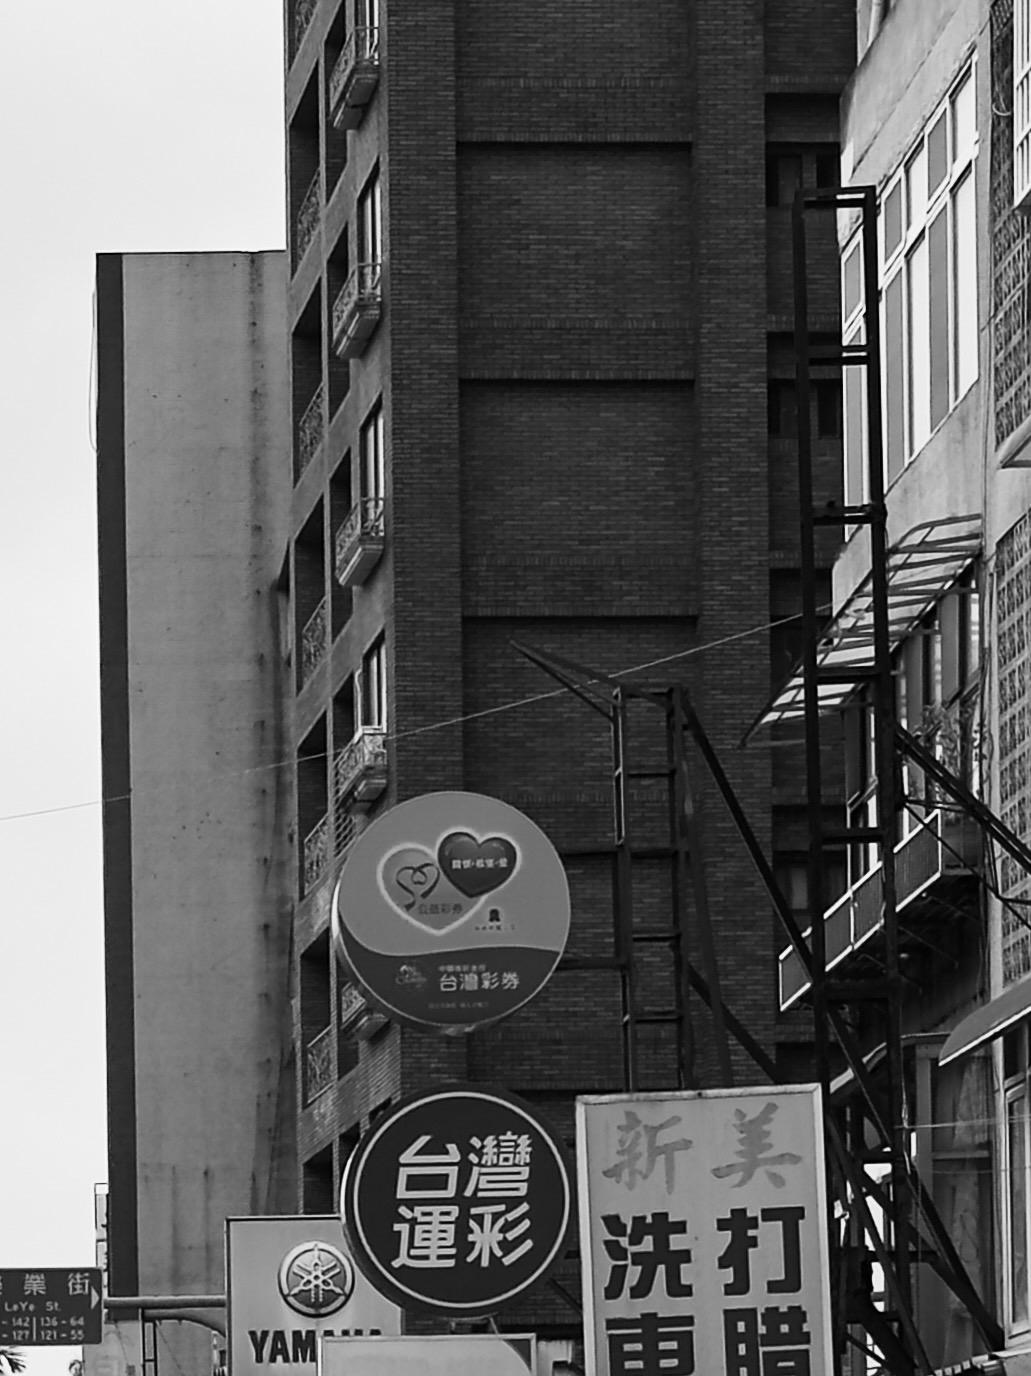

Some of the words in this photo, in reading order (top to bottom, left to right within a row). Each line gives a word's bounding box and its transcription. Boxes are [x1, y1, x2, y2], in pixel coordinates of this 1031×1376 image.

[439, 970, 520, 992] 台灣彩券
[396, 1131, 533, 1199] 台灣
[391, 1201, 534, 1269] 運彩
[248, 1328, 382, 1364] YAM
